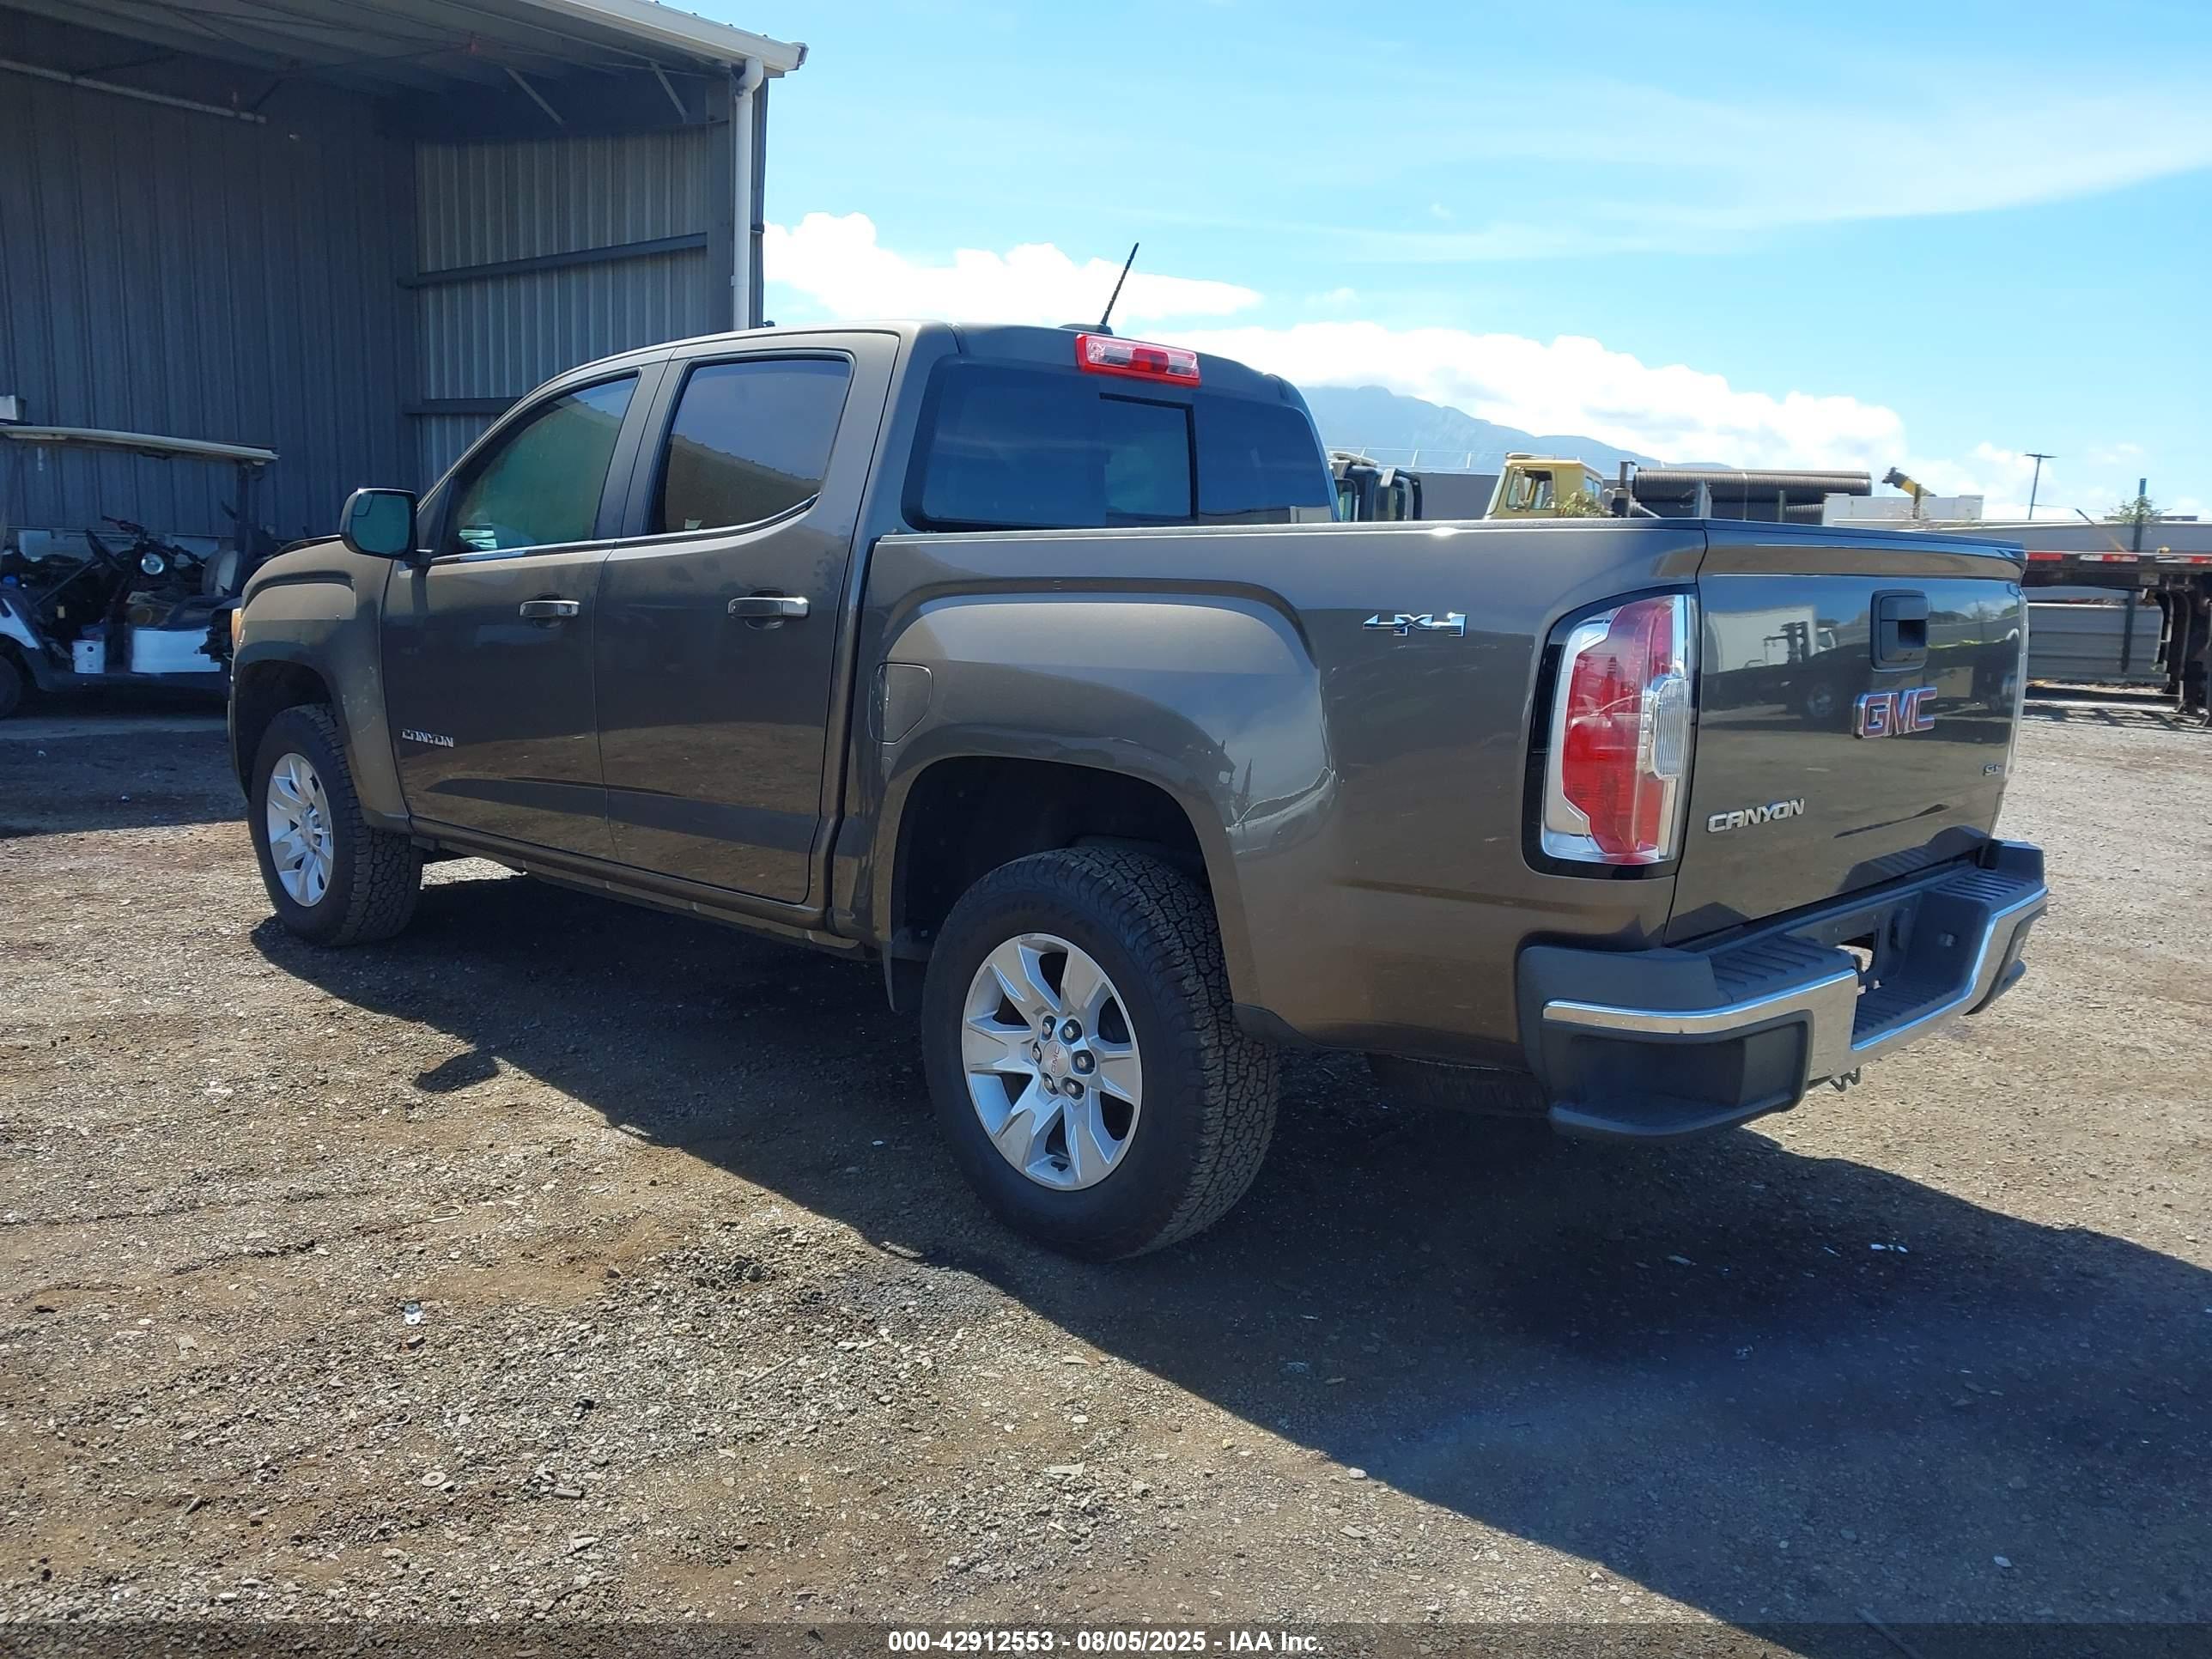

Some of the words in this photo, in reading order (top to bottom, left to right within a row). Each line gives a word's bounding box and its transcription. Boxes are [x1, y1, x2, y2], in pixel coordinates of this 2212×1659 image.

[1854, 686, 1937, 738] GMC
[400, 728, 454, 747] CANYON
[1707, 798, 1805, 833] CANYON
